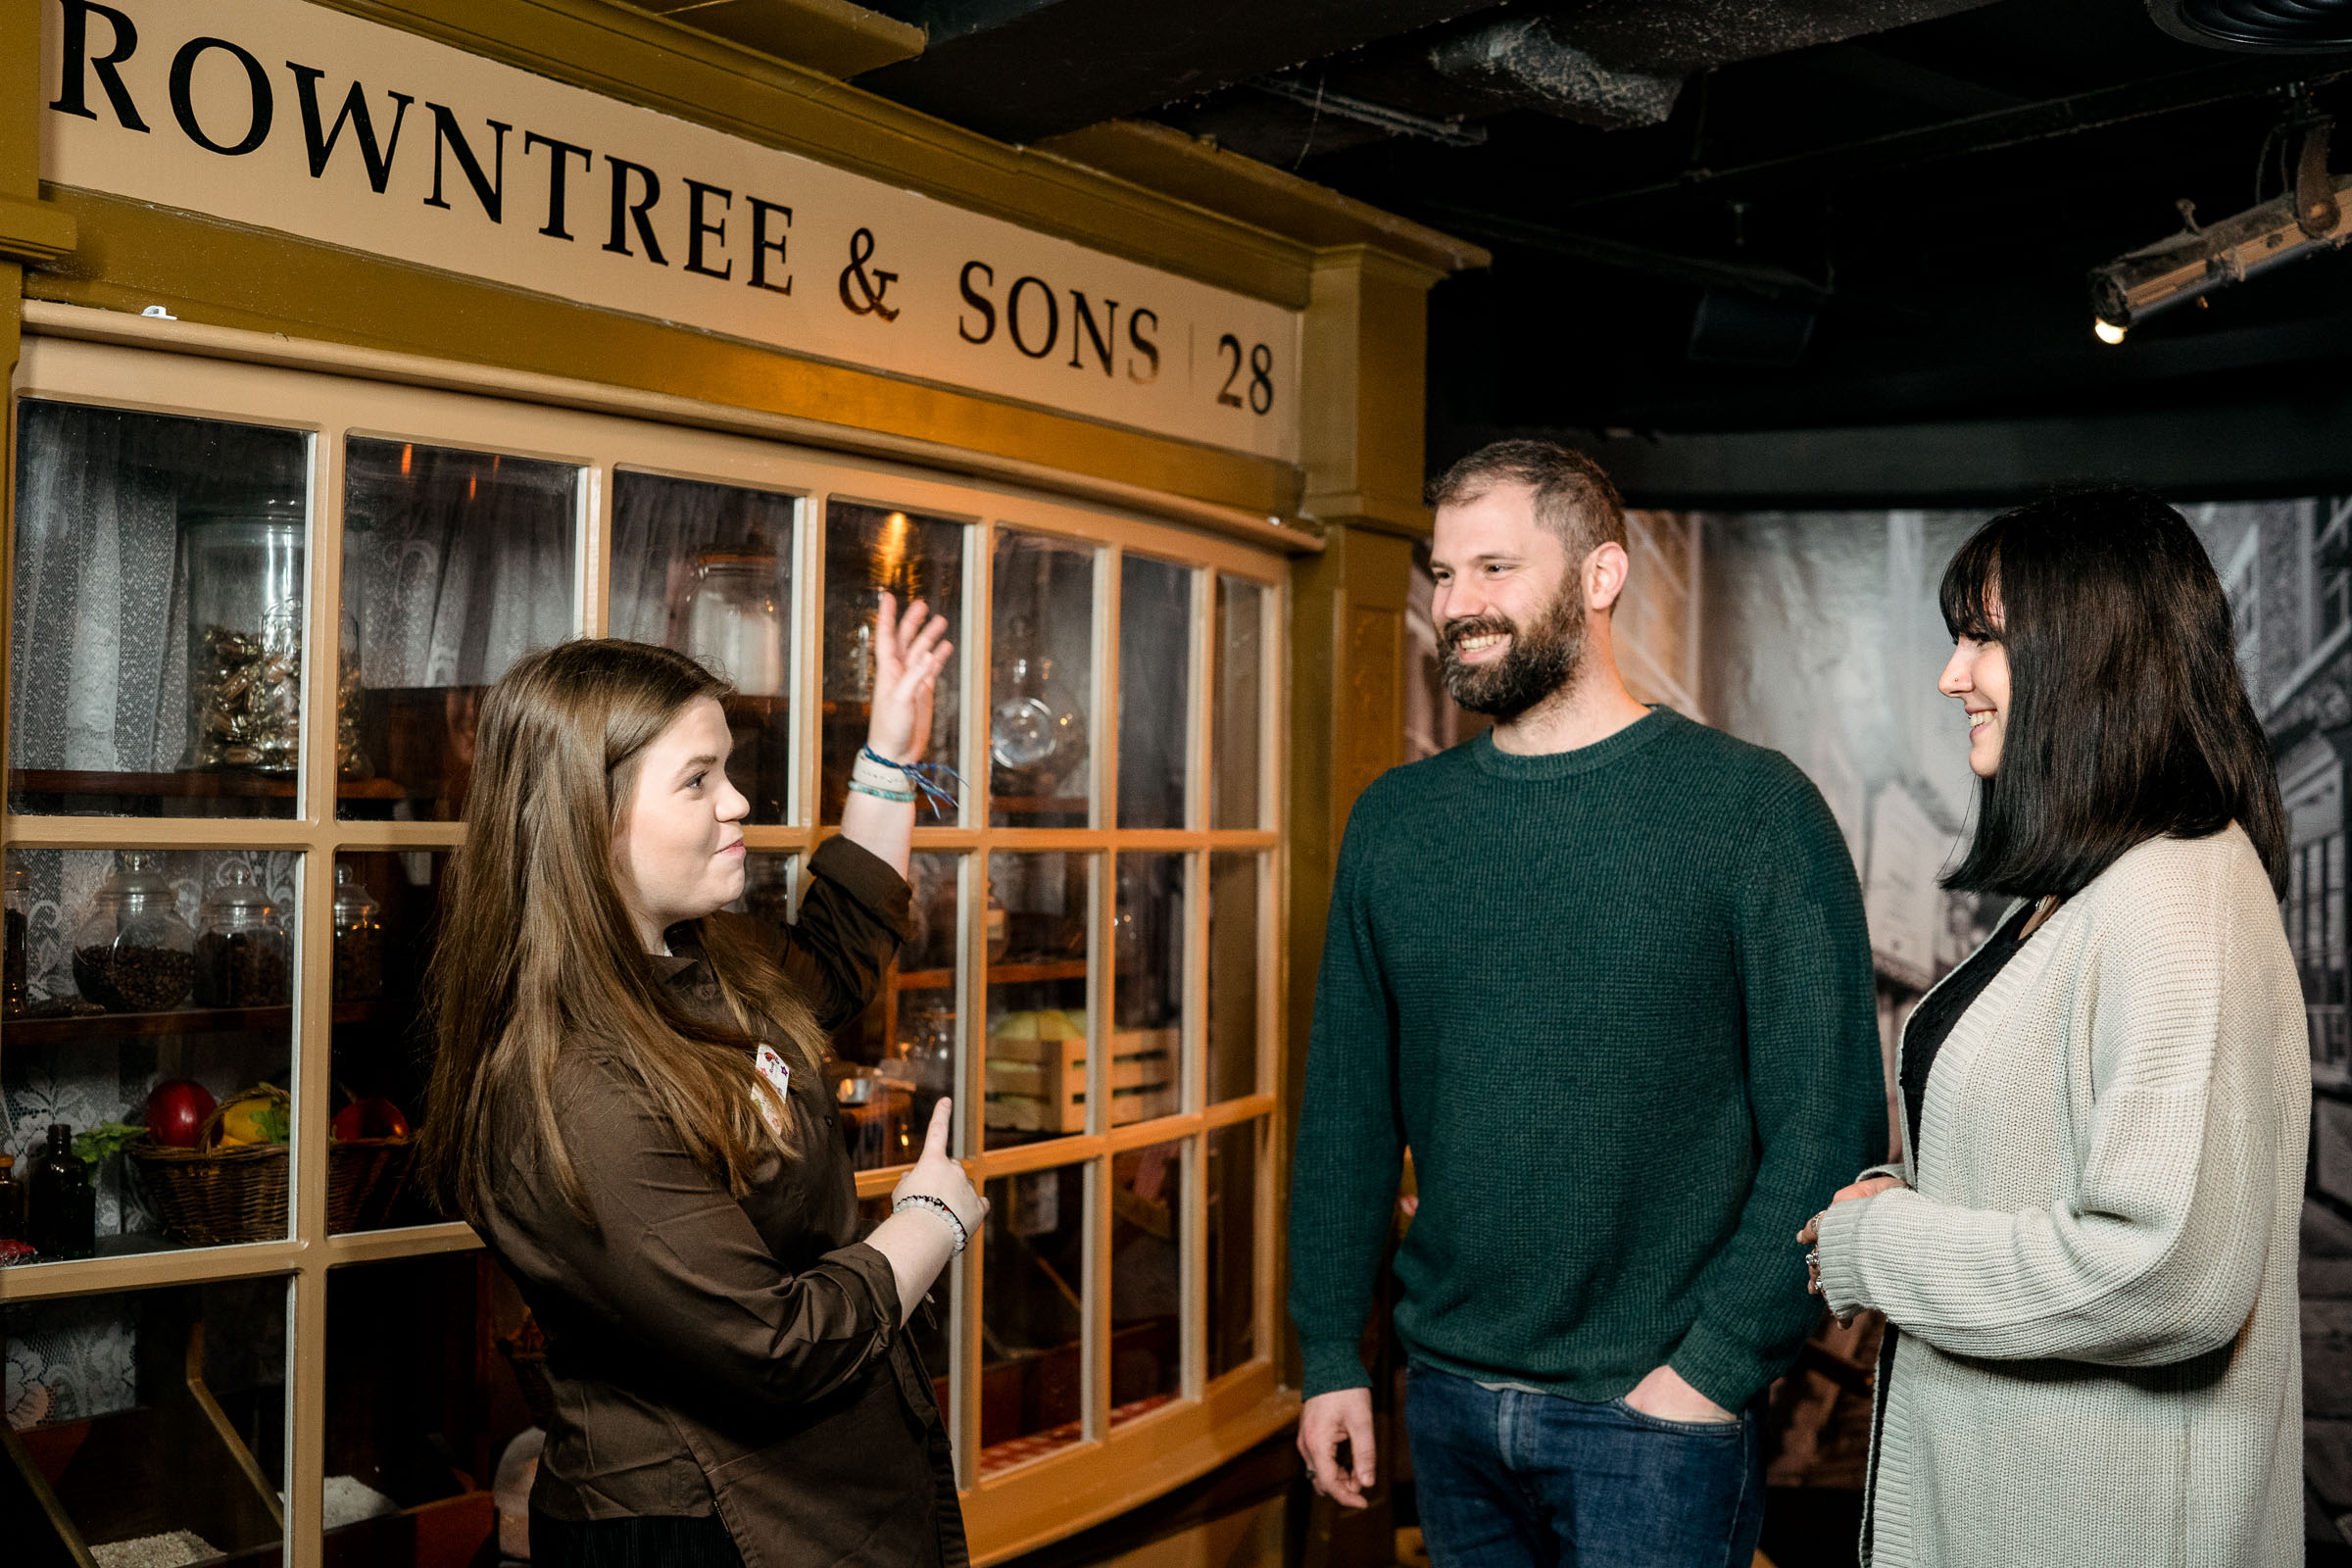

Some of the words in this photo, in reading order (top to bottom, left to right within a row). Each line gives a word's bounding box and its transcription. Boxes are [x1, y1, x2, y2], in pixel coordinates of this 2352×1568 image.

[49, 0, 794, 296] ROWNTREE
[838, 227, 900, 322] &
[958, 261, 1159, 384] SONS
[1216, 333, 1274, 416] 28
